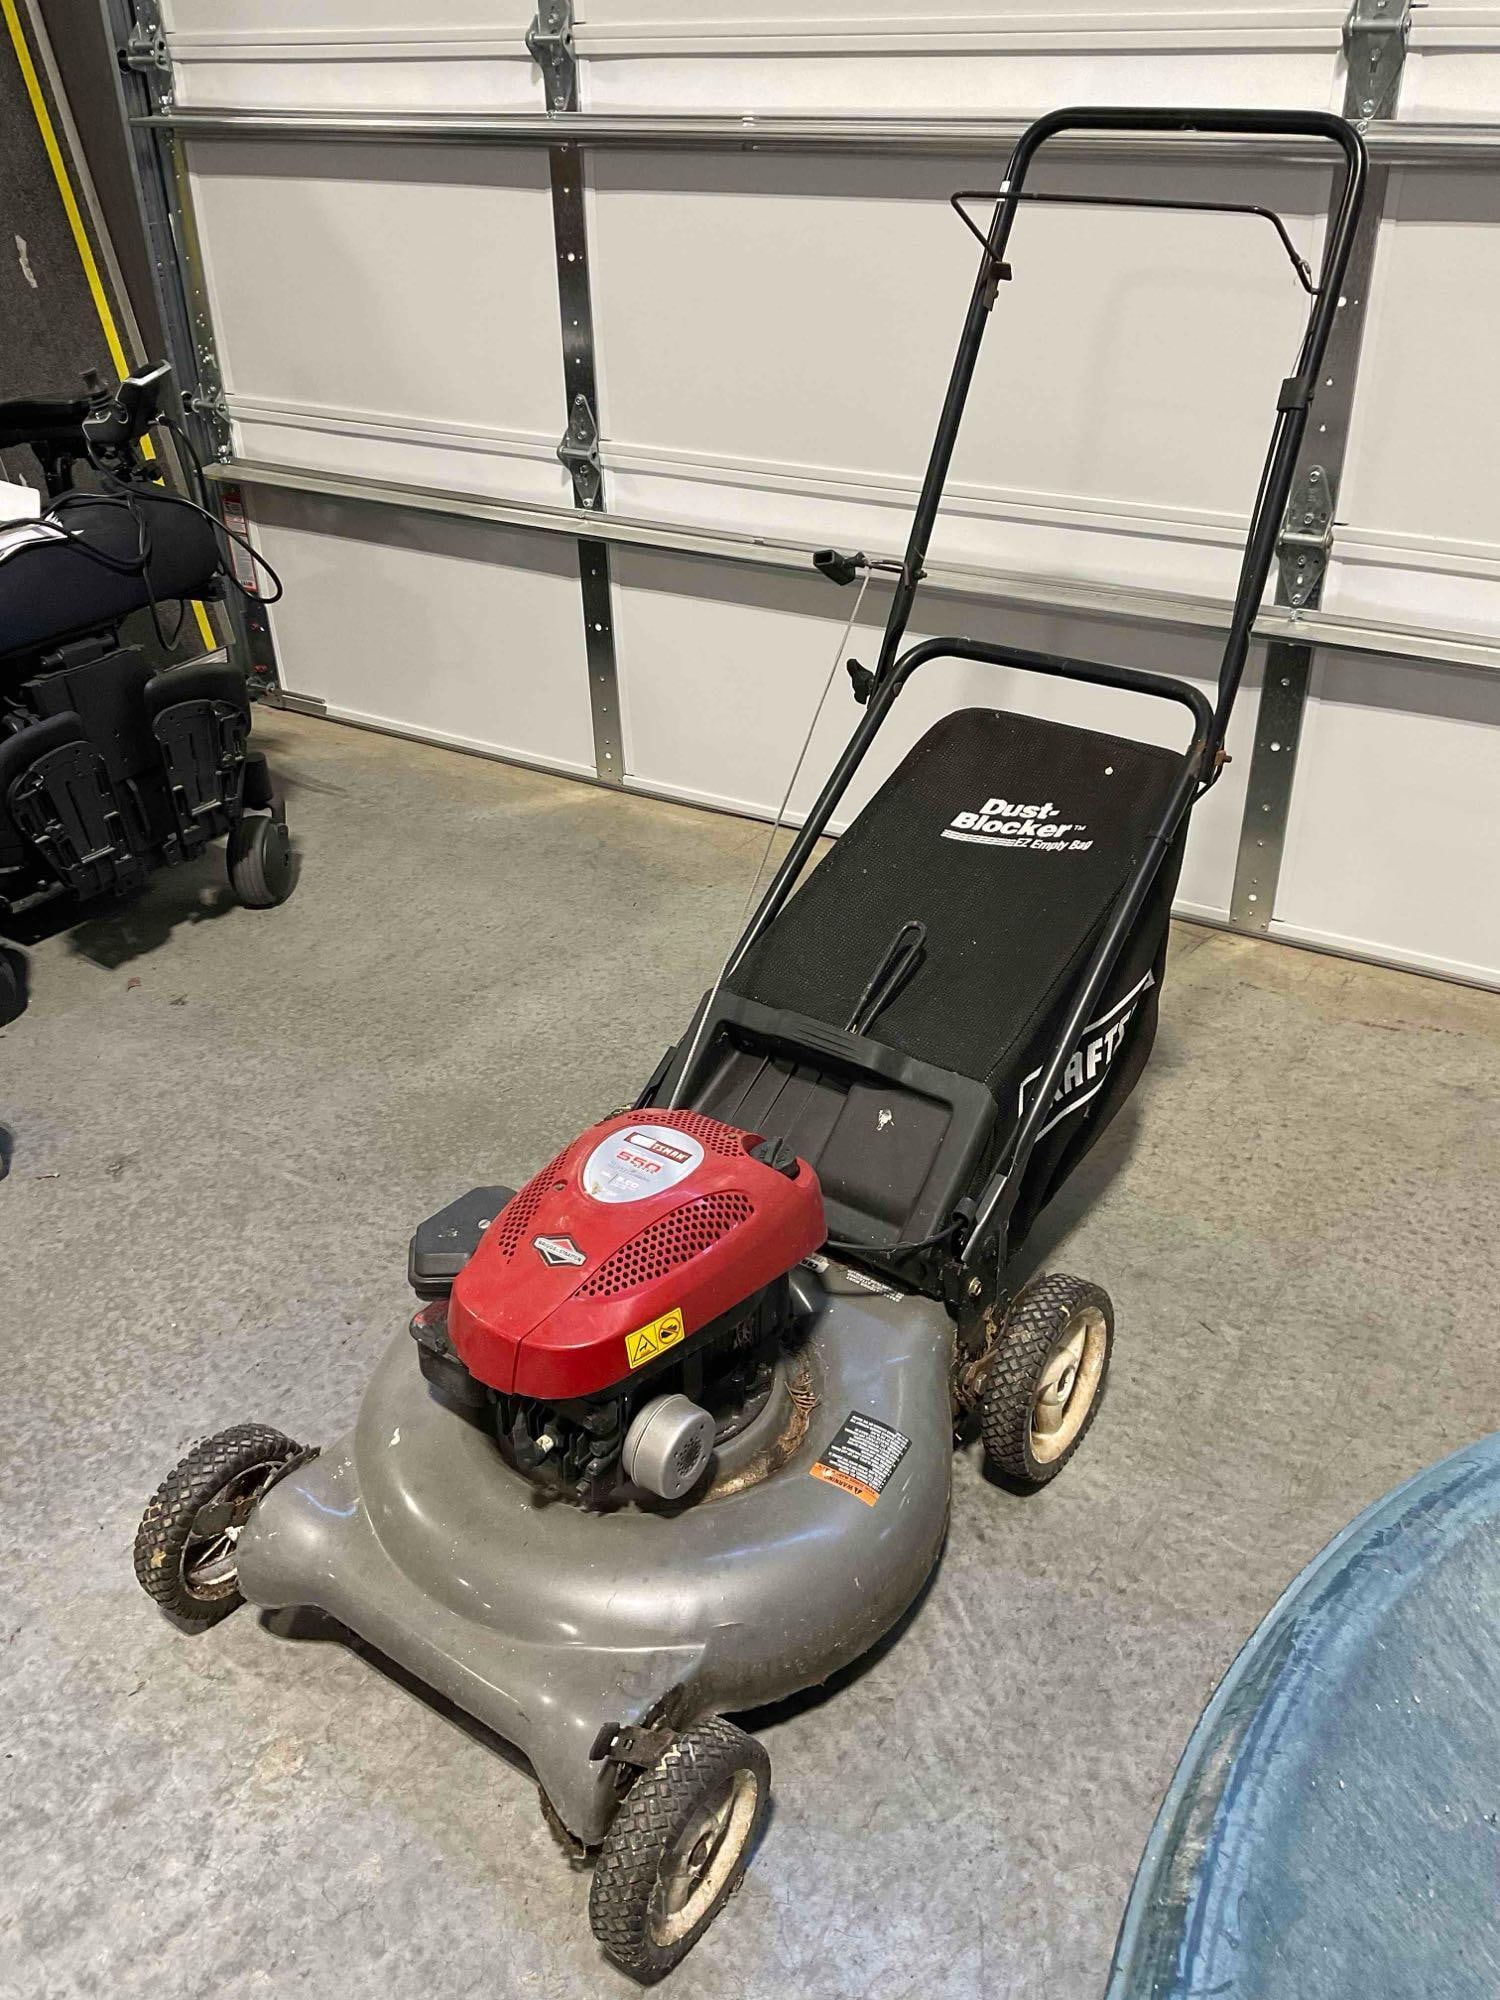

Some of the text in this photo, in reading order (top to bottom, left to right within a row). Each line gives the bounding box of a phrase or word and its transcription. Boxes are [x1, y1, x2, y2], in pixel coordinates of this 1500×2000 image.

[979, 798, 1060, 820] Dust-
[950, 811, 1072, 838] Blocker
[1014, 838, 1093, 851] EZ Empty Bag
